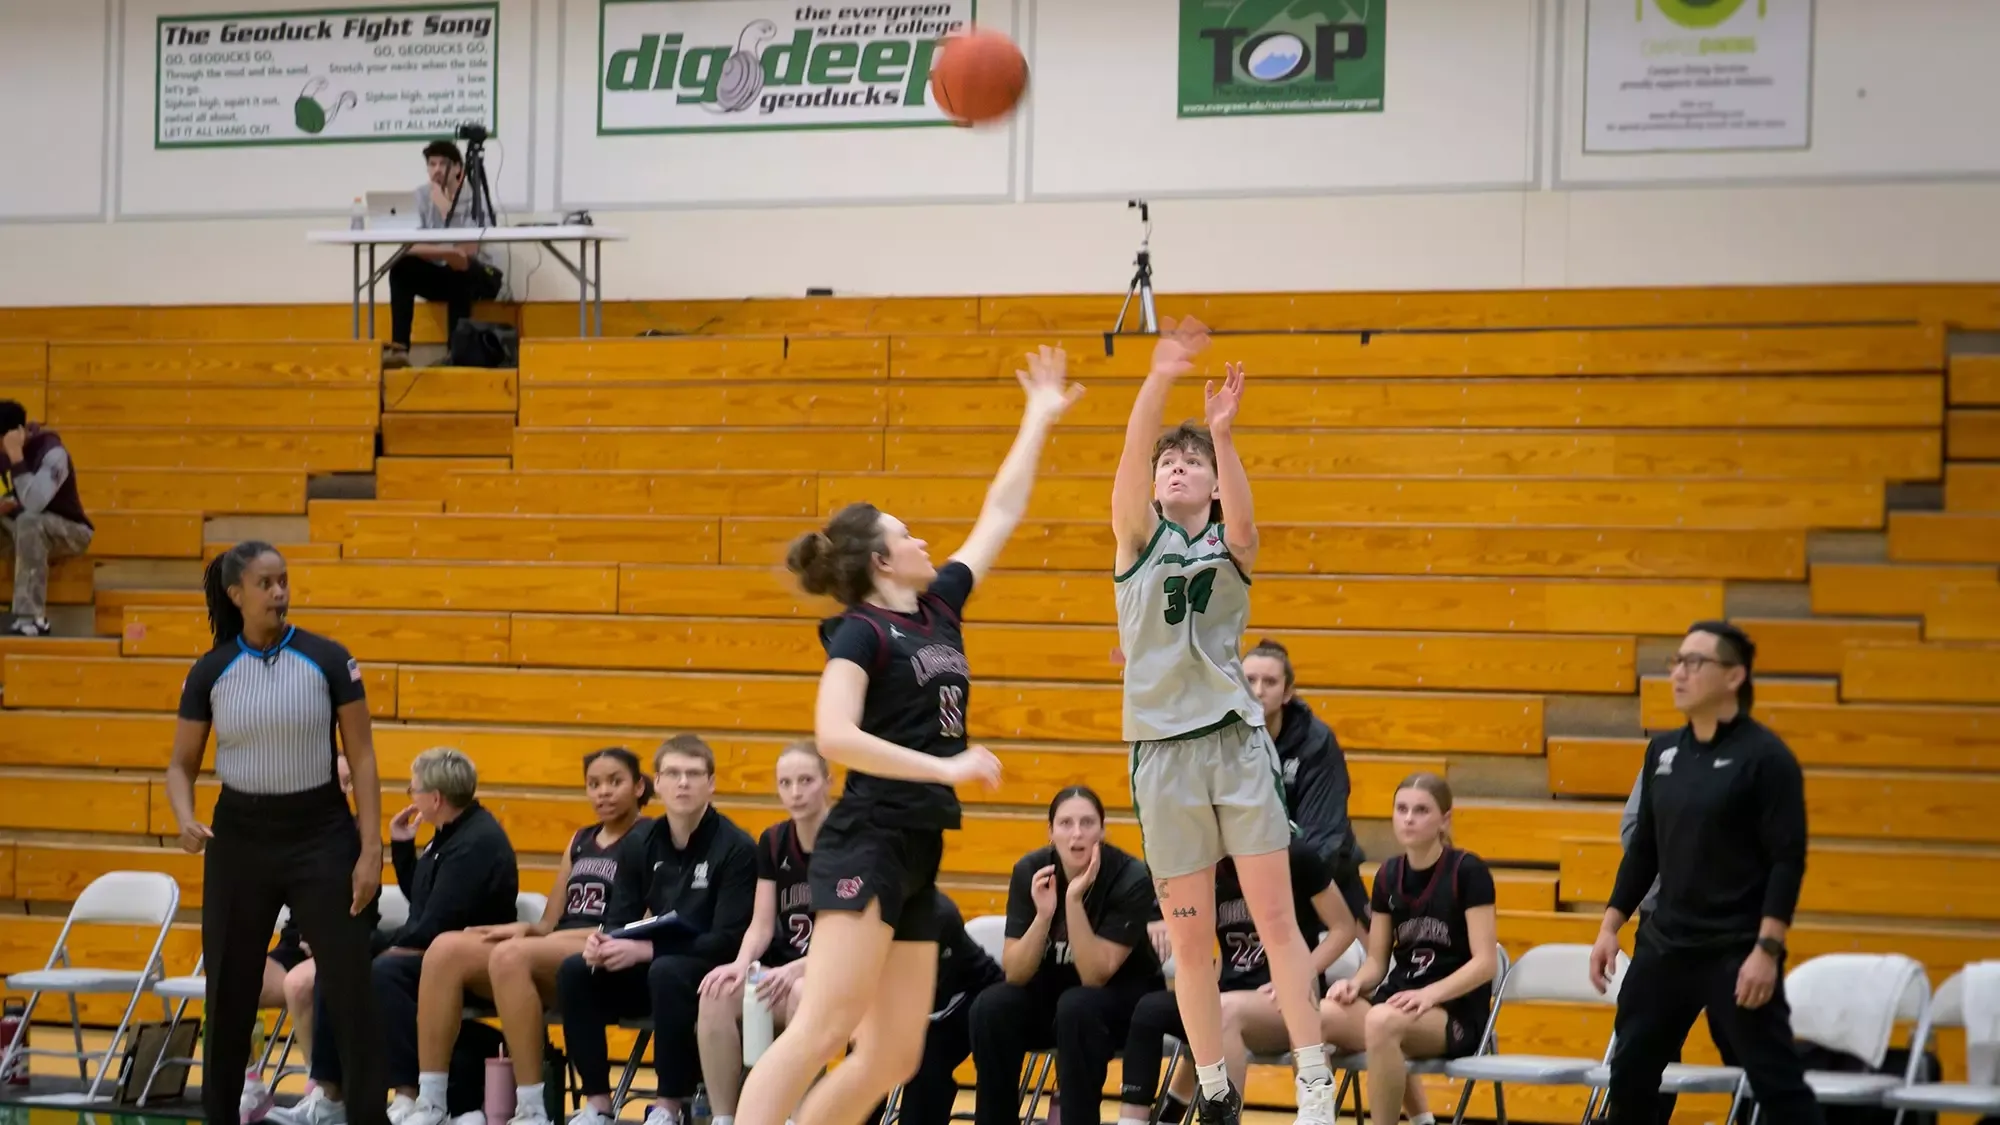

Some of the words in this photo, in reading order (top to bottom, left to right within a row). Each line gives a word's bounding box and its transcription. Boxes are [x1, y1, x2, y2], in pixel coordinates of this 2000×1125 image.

[795, 5, 832, 21] the
[838, 4, 951, 21] evergreen
[165, 24, 211, 46] The
[220, 19, 334, 44] Geoduck
[342, 16, 414, 43] Fight
[423, 14, 492, 39] Song
[816, 22, 877, 37] state
[884, 19, 963, 37] college
[398, 42, 464, 56] GEODUCKS
[1199, 23, 1368, 85] TOP
[189, 51, 251, 65] GEODUCKS
[328, 62, 364, 74] Stretch
[366, 63, 388, 75] your
[390, 60, 418, 71] necks
[421, 59, 448, 70] when
[450, 58, 466, 69] the
[468, 56, 488, 68] tide
[165, 68, 204, 81] Through
[206, 67, 221, 78] the
[224, 67, 245, 77] mud
[248, 66, 265, 77] and
[267, 65, 283, 76] the
[605, 32, 733, 105] dig
[456, 74, 465, 84] is
[164, 98, 197, 111] Siphon
[224, 96, 251, 109] squirt
[365, 90, 398, 104] Siphon
[427, 89, 455, 102] squirt
[759, 86, 900, 114] geoducks
[408, 105, 439, 116] swivel
[442, 103, 453, 115] all
[164, 113, 193, 124] swivel
[195, 112, 207, 123] all
[373, 120, 391, 131] LET
[394, 119, 403, 131] IT
[406, 118, 424, 130] ALL
[427, 118, 459, 129] HANG
[164, 127, 181, 138] LET
[184, 126, 193, 137] IT
[196, 125, 212, 136] ALL
[216, 125, 247, 136] HANG
[1163, 567, 1218, 625] 34
[567, 882, 607, 917] 22
[1172, 905, 1198, 918] 444
